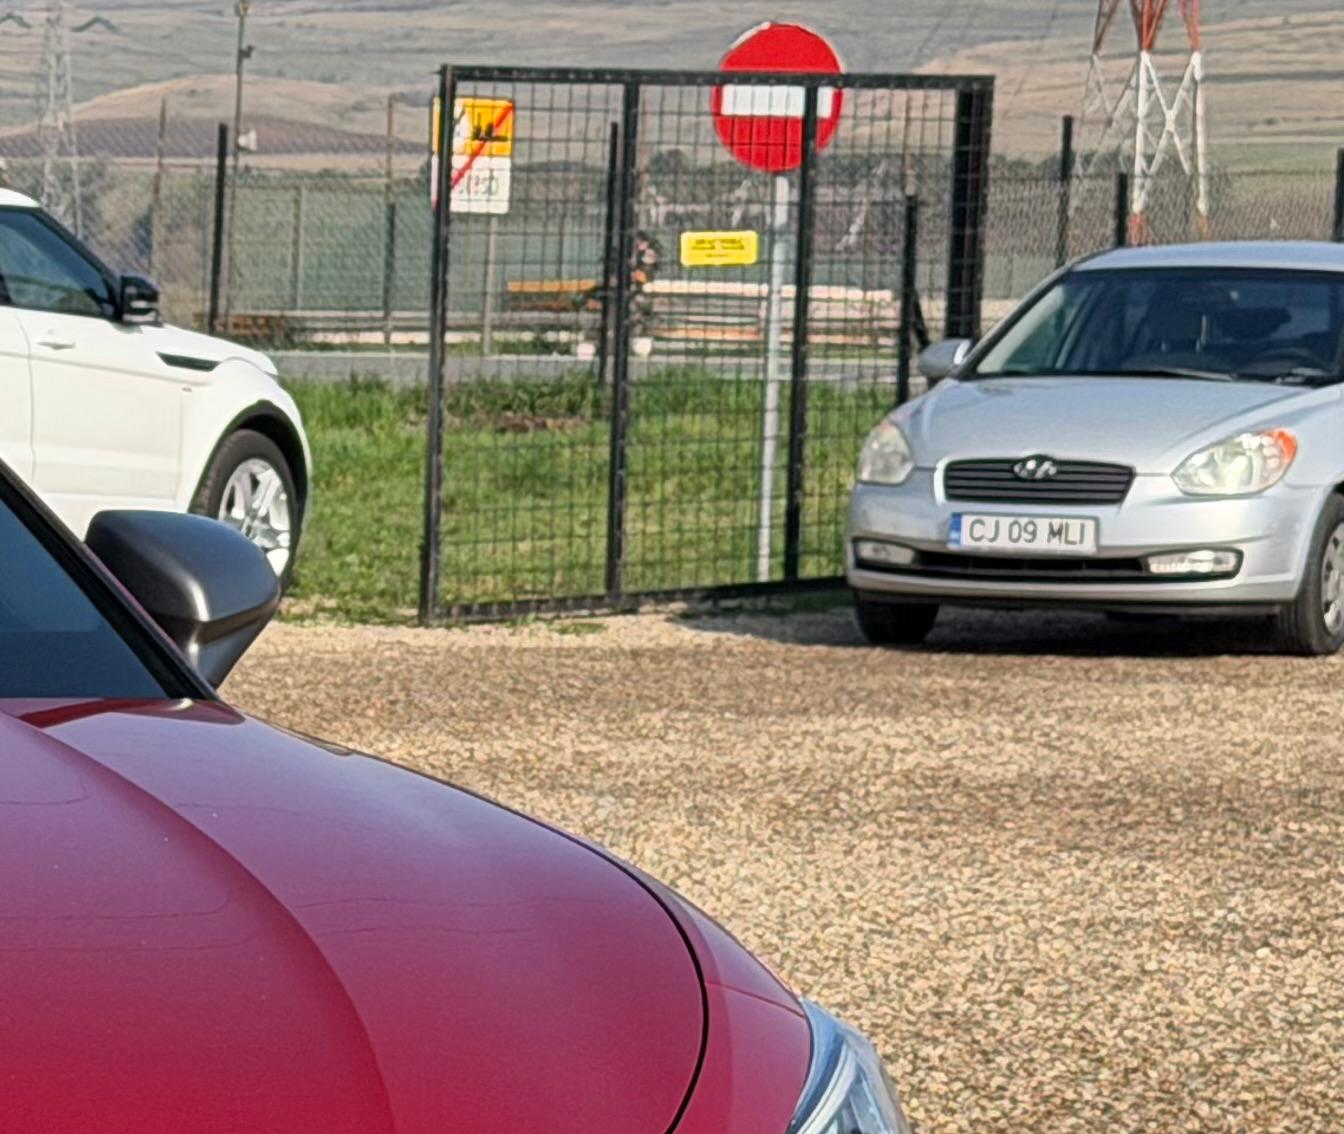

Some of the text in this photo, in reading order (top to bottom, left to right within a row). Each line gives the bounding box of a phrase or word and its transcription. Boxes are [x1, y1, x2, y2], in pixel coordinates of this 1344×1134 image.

[969, 518, 1000, 543] CJ
[1008, 519, 1038, 544] 09
[1047, 521, 1085, 546] MLI
